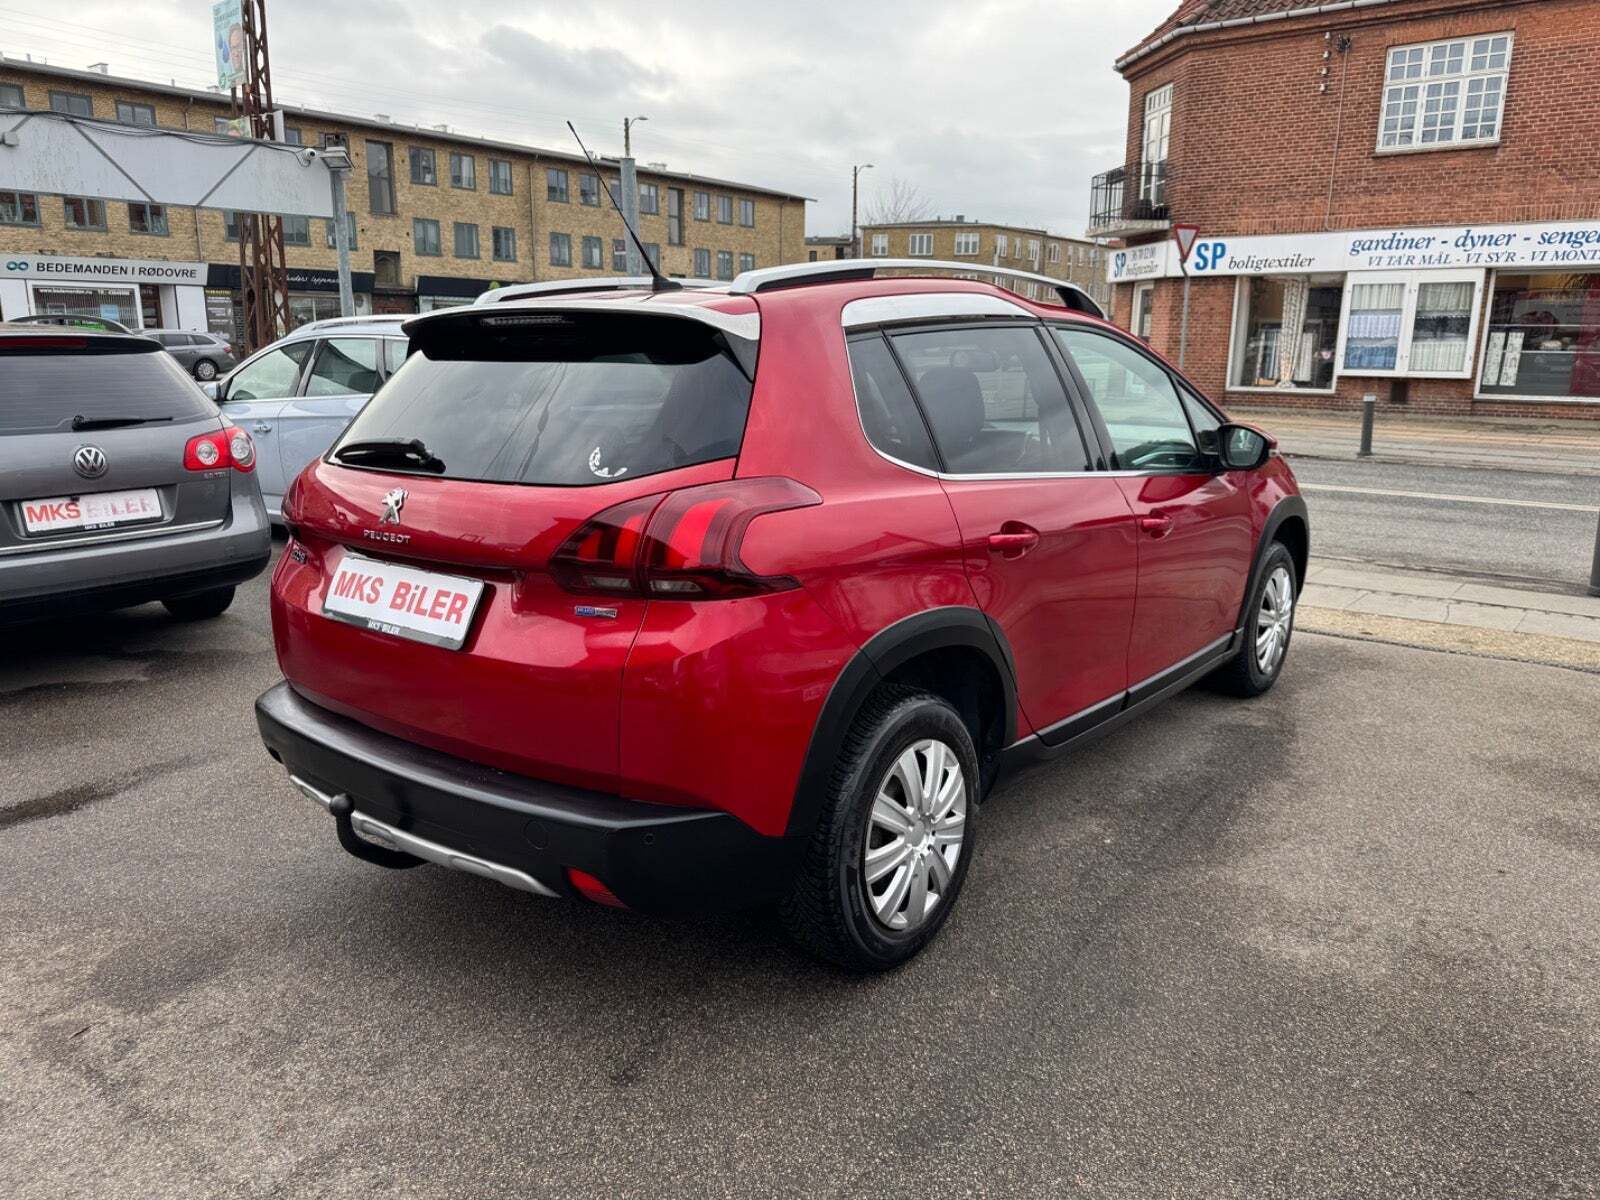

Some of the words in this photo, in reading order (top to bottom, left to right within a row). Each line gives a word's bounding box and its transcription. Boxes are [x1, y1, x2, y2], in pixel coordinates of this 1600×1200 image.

[1349, 232, 1436, 256] gardiner
[1454, 229, 1517, 252] dyner
[1537, 229, 1600, 249] senge
[1114, 252, 1127, 278] SP
[1194, 242, 1226, 271] SP
[1228, 254, 1315, 272] boligtextiler
[1367, 256, 1383, 267] VI
[1464, 253, 1482, 264] VI
[1531, 250, 1548, 262] VI
[1550, 249, 1600, 261] MONT
[36, 262, 128, 275] BEDEMANDEN
[131, 267, 135, 275] I
[138, 266, 197, 278] RØDOVRE
[26, 502, 81, 524] MKS
[363, 529, 412, 544] PEUGEOT
[333, 570, 384, 604] MKS
